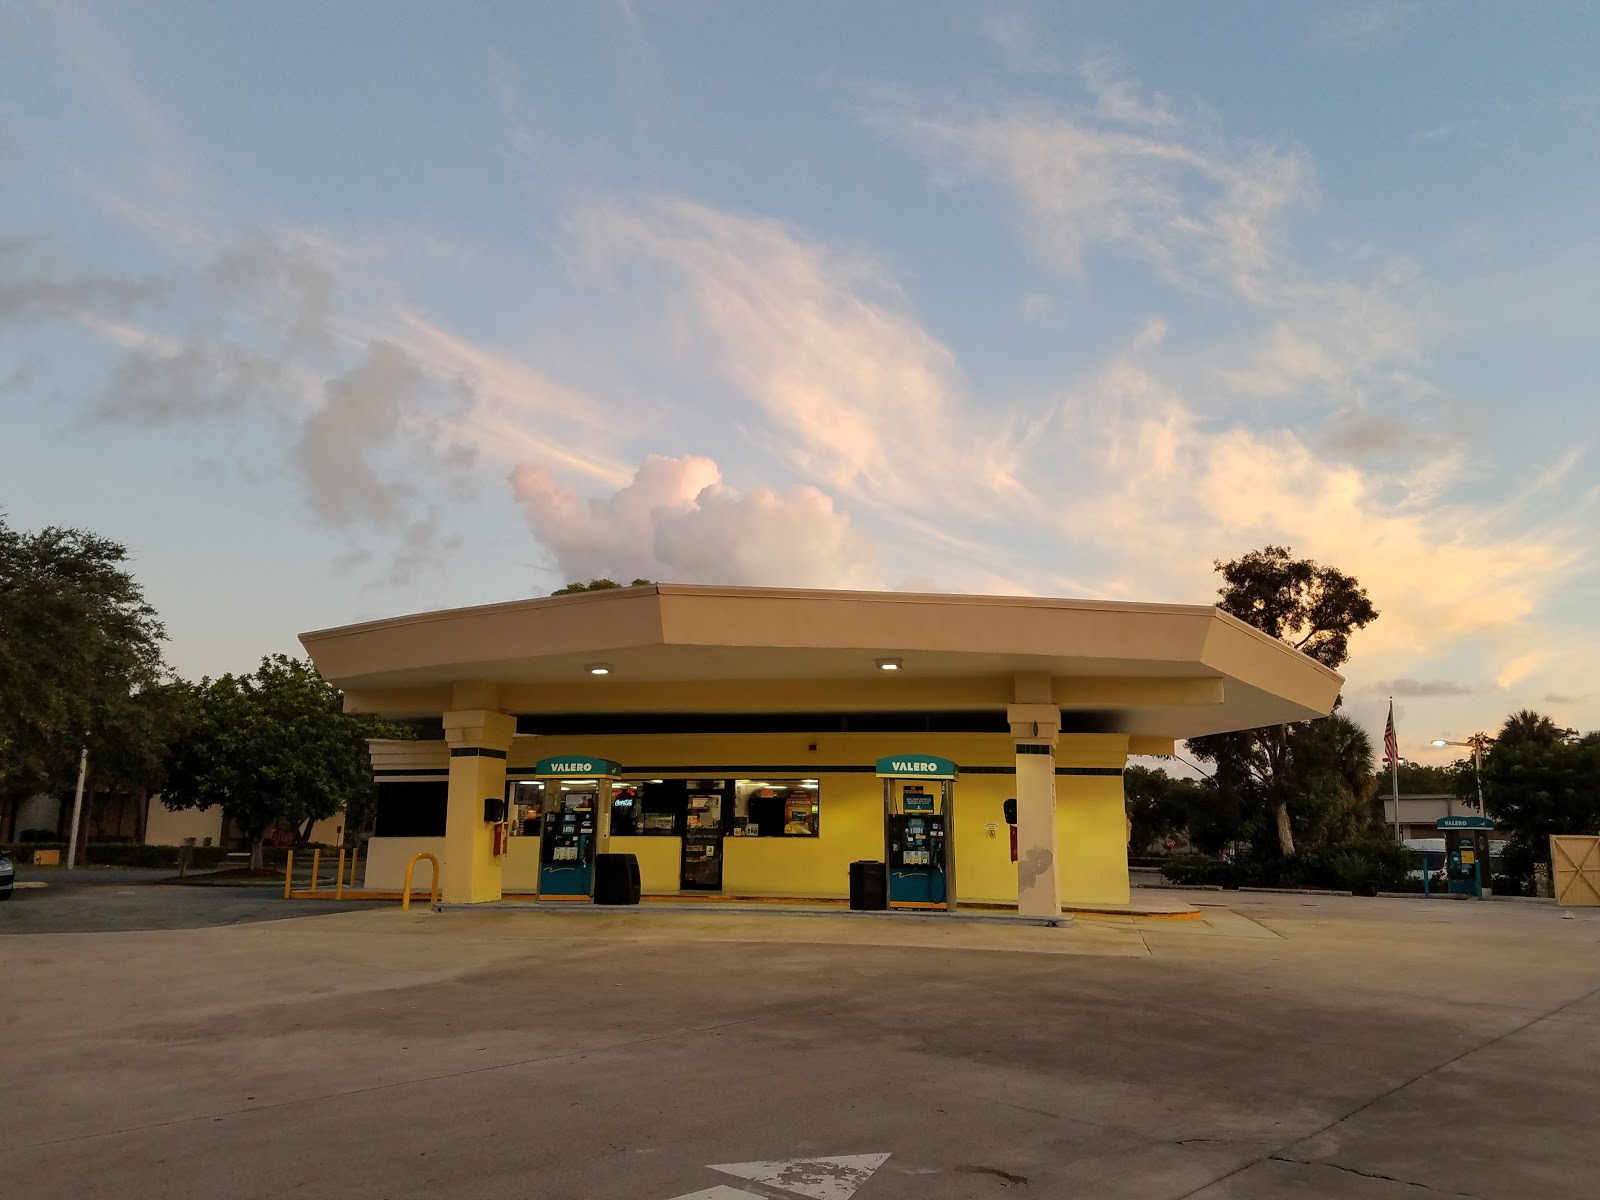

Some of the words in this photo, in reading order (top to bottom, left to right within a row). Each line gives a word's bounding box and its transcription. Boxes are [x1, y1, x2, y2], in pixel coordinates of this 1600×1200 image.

[551, 763, 592, 771] VALERO
[892, 762, 937, 771] VALERO
[272, 833, 292, 842] STOP
